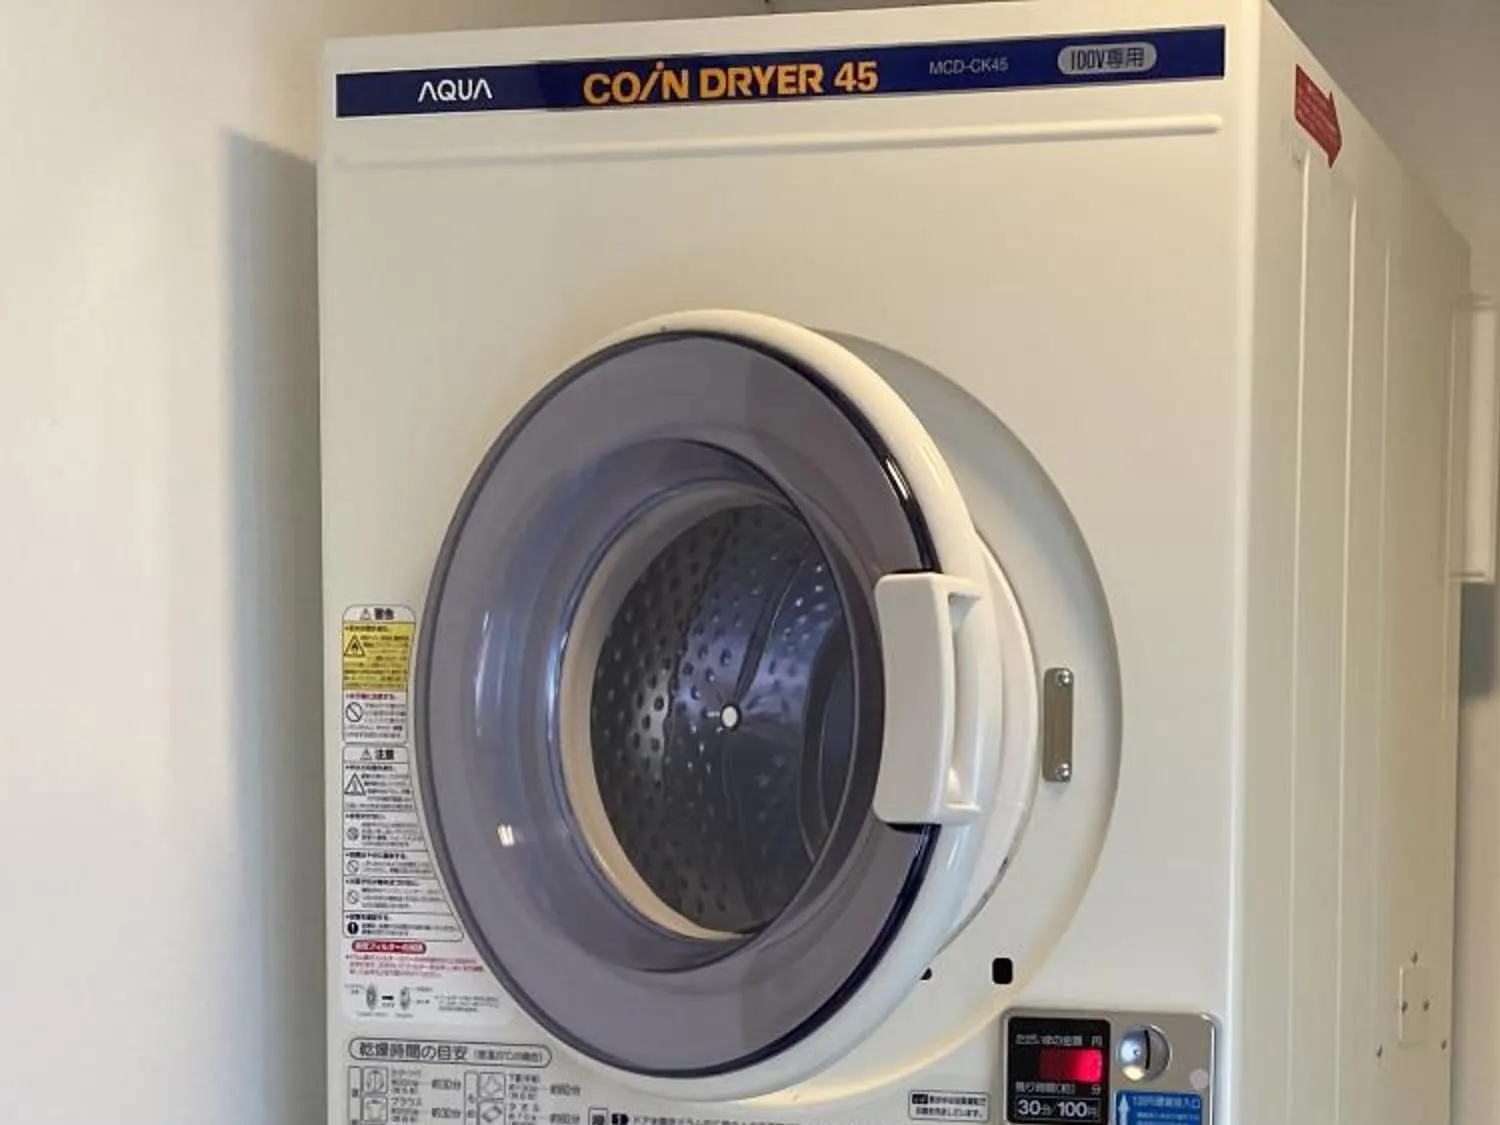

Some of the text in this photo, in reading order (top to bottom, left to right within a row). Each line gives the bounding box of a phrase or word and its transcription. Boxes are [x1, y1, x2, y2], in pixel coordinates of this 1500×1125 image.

[929, 57, 1009, 76] MCD-CK45
[418, 79, 493, 102] AQUA
[699, 62, 824, 99] DRYER
[833, 61, 879, 92] 45
[359, 1041, 468, 1061] 乾燥時間の目安
